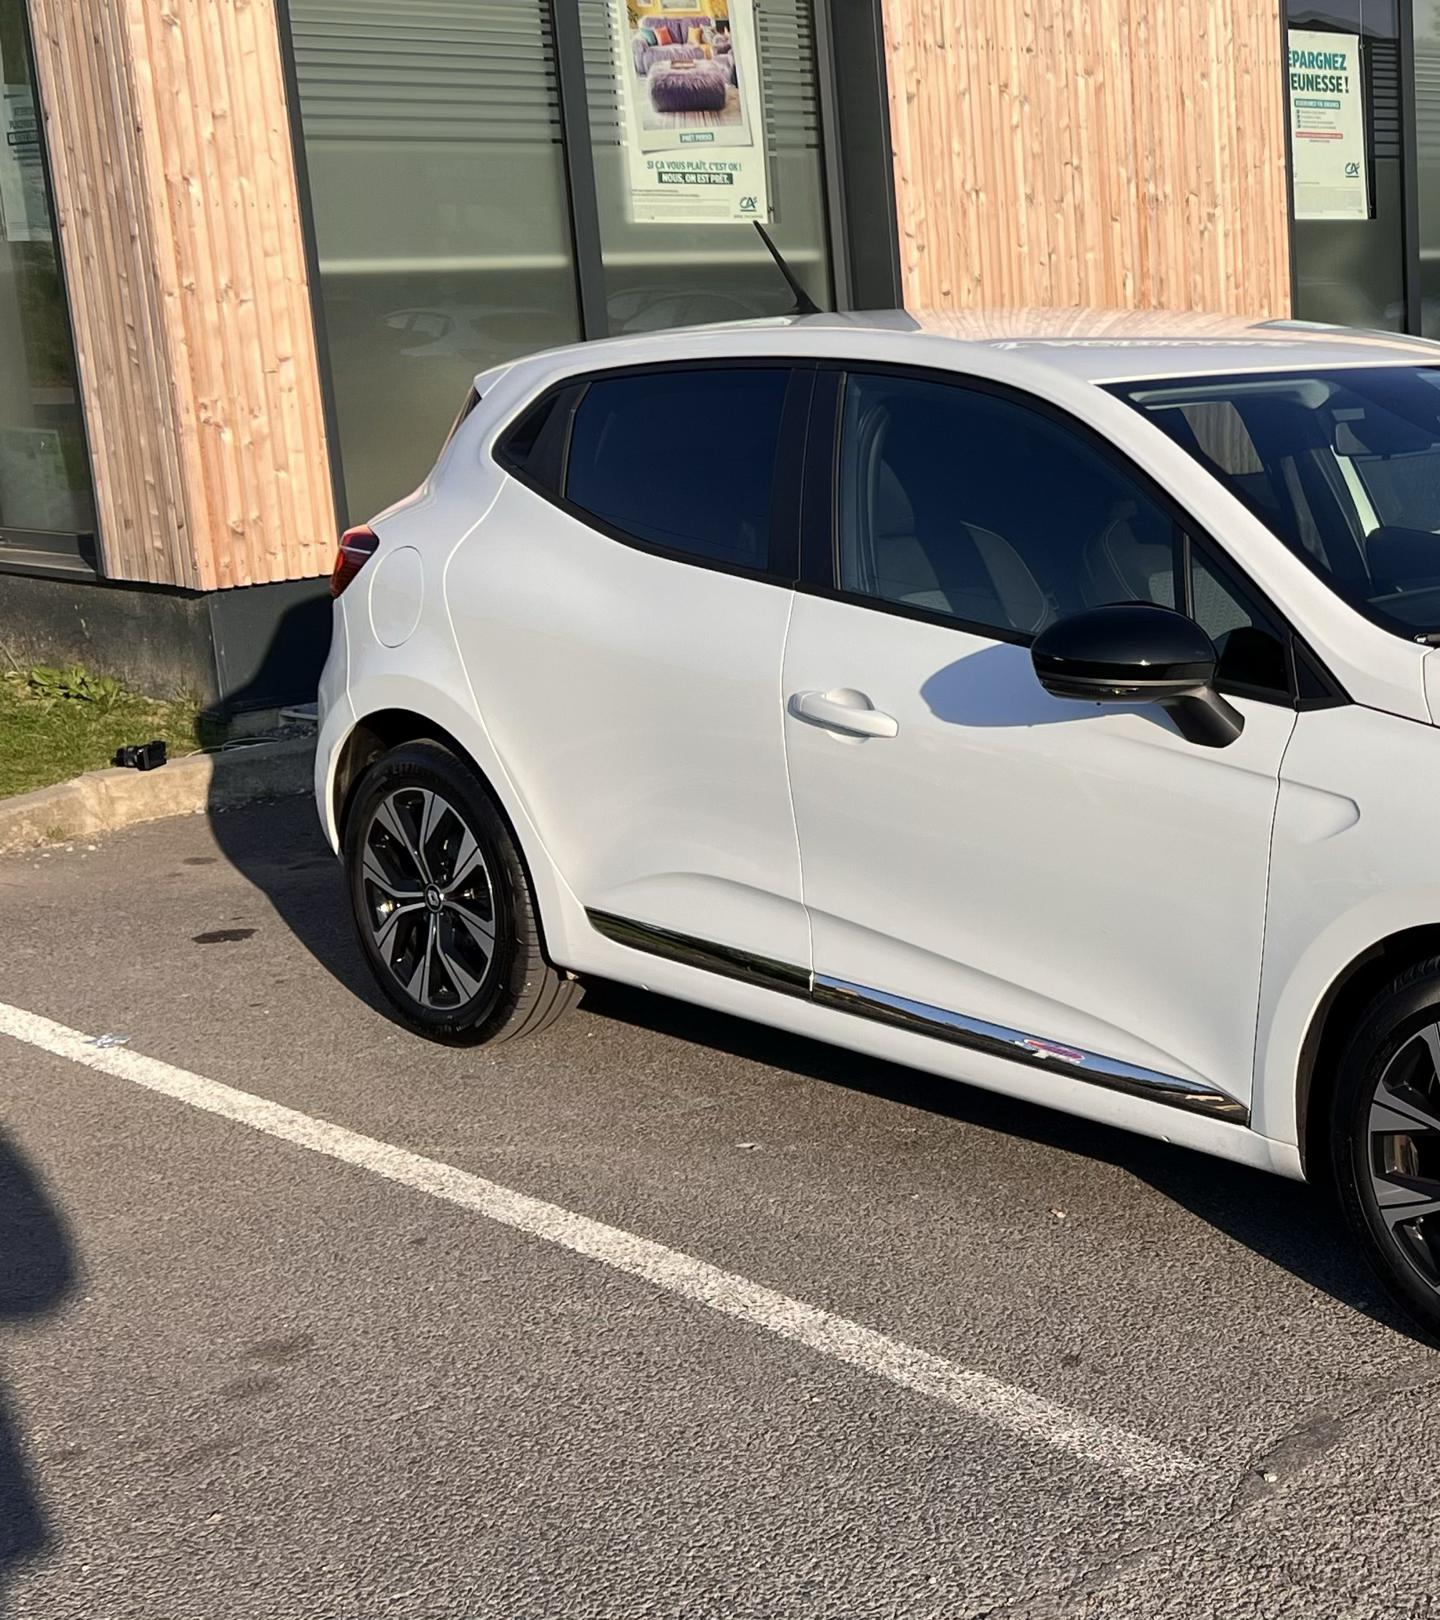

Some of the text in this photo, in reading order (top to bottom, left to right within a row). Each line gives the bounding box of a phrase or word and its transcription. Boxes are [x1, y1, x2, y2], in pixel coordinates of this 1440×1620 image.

[1290, 73, 1343, 93] EUNESSE
[666, 161, 686, 170] VOUS
[685, 174, 696, 183] ON
[697, 174, 710, 183] EST
